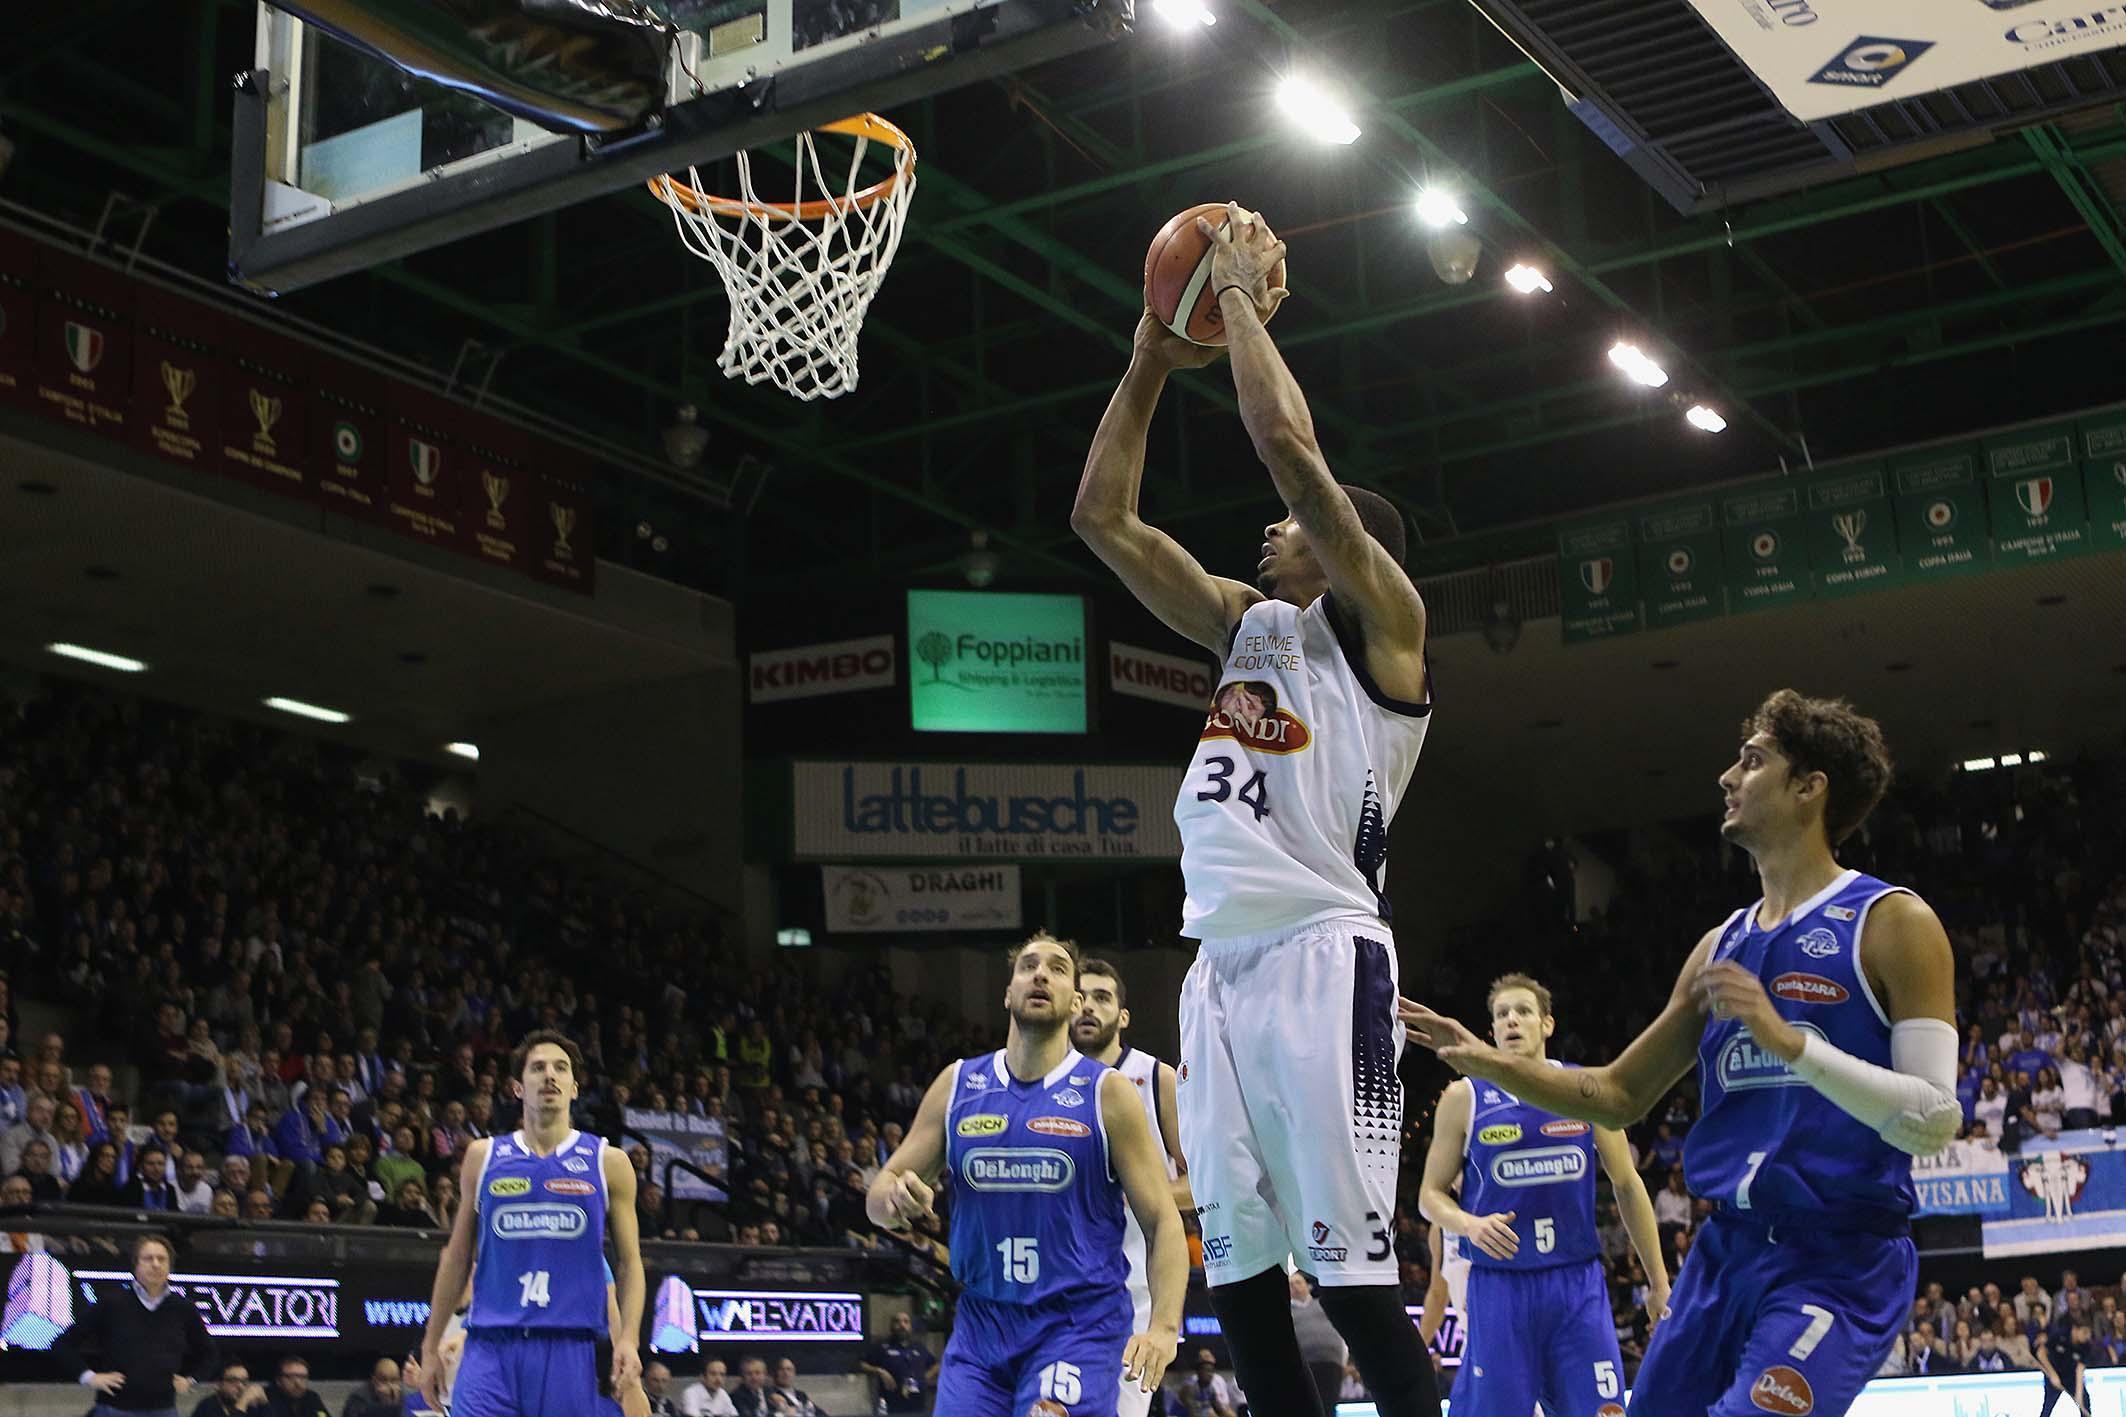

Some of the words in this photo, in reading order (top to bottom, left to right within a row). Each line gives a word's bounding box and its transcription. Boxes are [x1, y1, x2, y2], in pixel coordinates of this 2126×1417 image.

[753, 649, 890, 690] KIMBO
[957, 634, 1081, 667] Foppiani
[1112, 655, 1209, 699] KIMBO
[1205, 709, 1290, 743] ONDI
[1197, 756, 1271, 823] 34
[909, 872, 1004, 894] DRAGHI
[1915, 1178, 2006, 1209] VISANA
[1366, 1211, 1398, 1262] 3
[1534, 1217, 1556, 1254] 5
[996, 1236, 1040, 1284] 15
[519, 1270, 551, 1308] 14
[1788, 1303, 1834, 1361] 7
[1039, 1360, 1082, 1405] 15
[1593, 1360, 1618, 1399] 5
